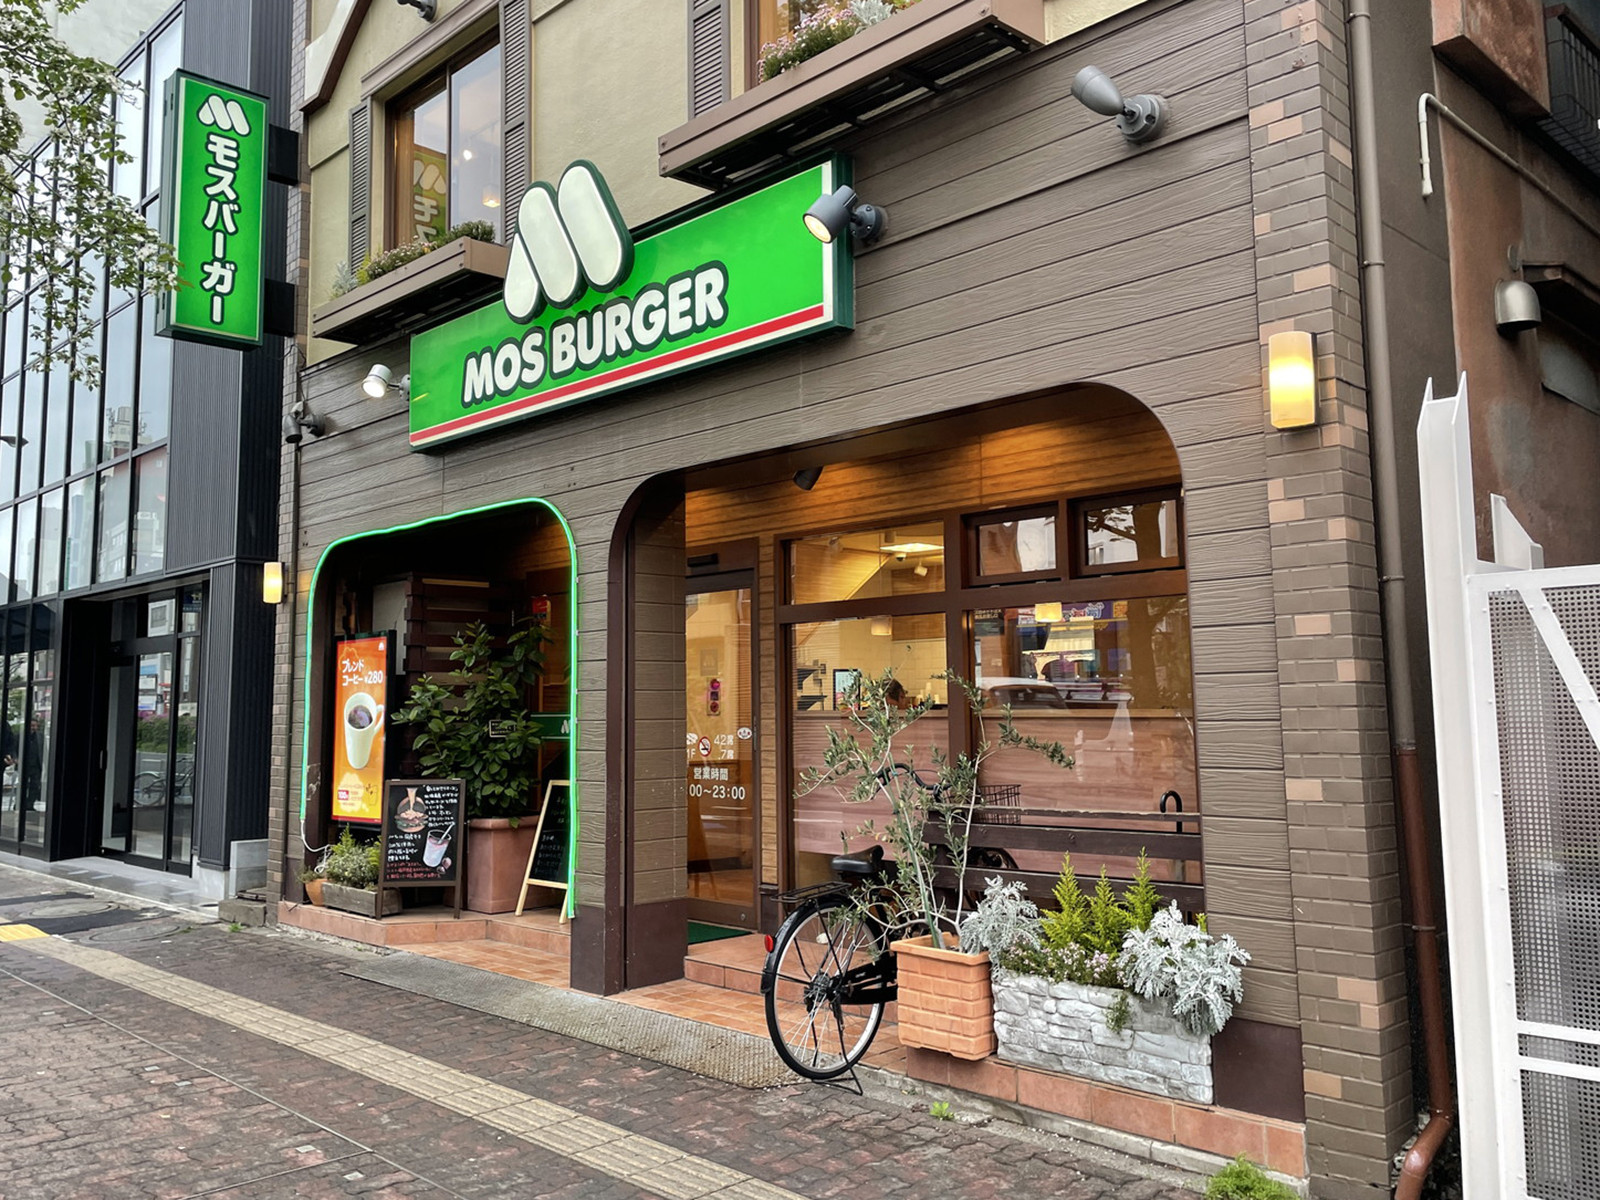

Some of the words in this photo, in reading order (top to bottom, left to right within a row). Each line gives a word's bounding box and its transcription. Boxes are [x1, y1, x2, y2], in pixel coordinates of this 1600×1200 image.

[203, 134, 240, 323] モスバーガー
[463, 336, 546, 404] MOS
[552, 267, 725, 375] BURGER
[342, 658, 365, 673] ブレンド
[342, 674, 364, 687] コーヒー
[693, 766, 729, 781] 営業時間
